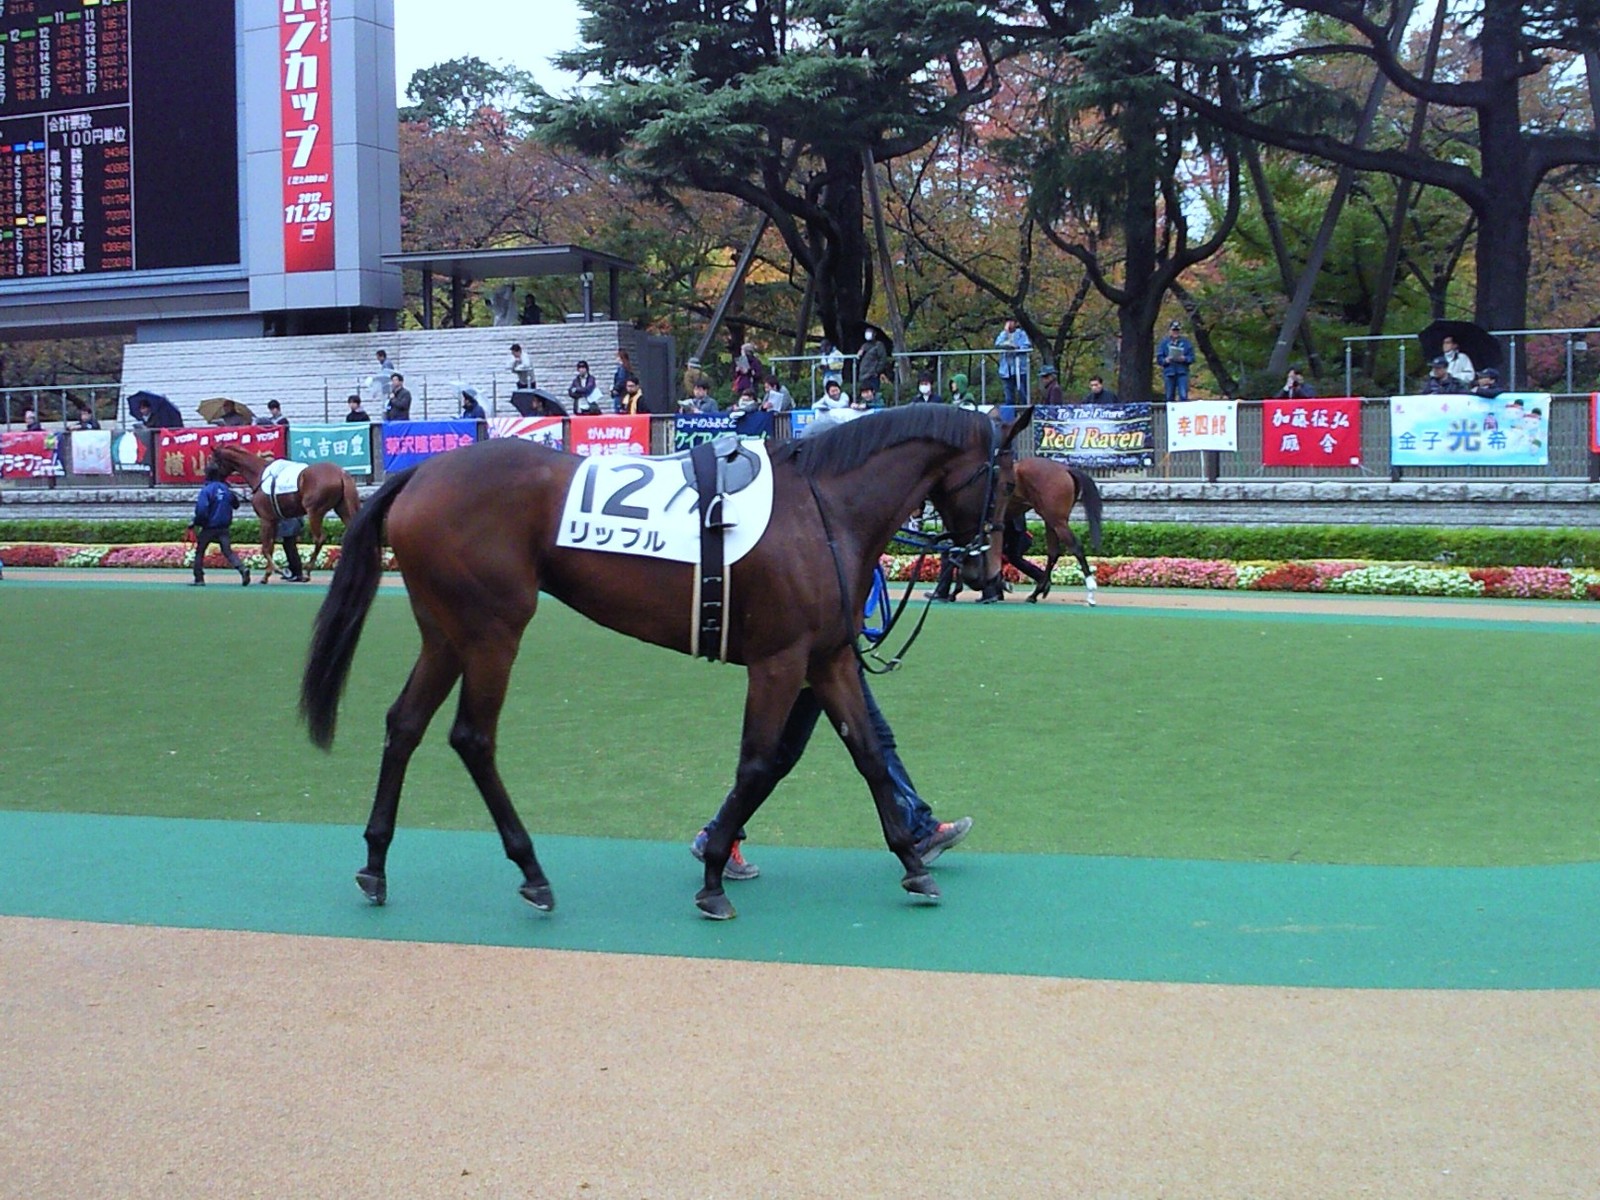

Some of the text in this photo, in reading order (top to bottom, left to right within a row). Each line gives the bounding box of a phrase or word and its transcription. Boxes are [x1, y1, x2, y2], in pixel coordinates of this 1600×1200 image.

[54, 11, 64, 24] 11
[298, 192, 322, 203] 2012
[27, 214, 35, 227] 5
[285, 202, 332, 223] 11.25
[1057, 408, 1125, 419] To The Future
[1177, 414, 1227, 437] 幸四郎
[1398, 419, 1508, 452] 金子光希
[317, 433, 364, 457] 吉田豊
[1040, 426, 1145, 449] Red Raven
[580, 463, 655, 520] 12
[570, 520, 667, 552] リップル
